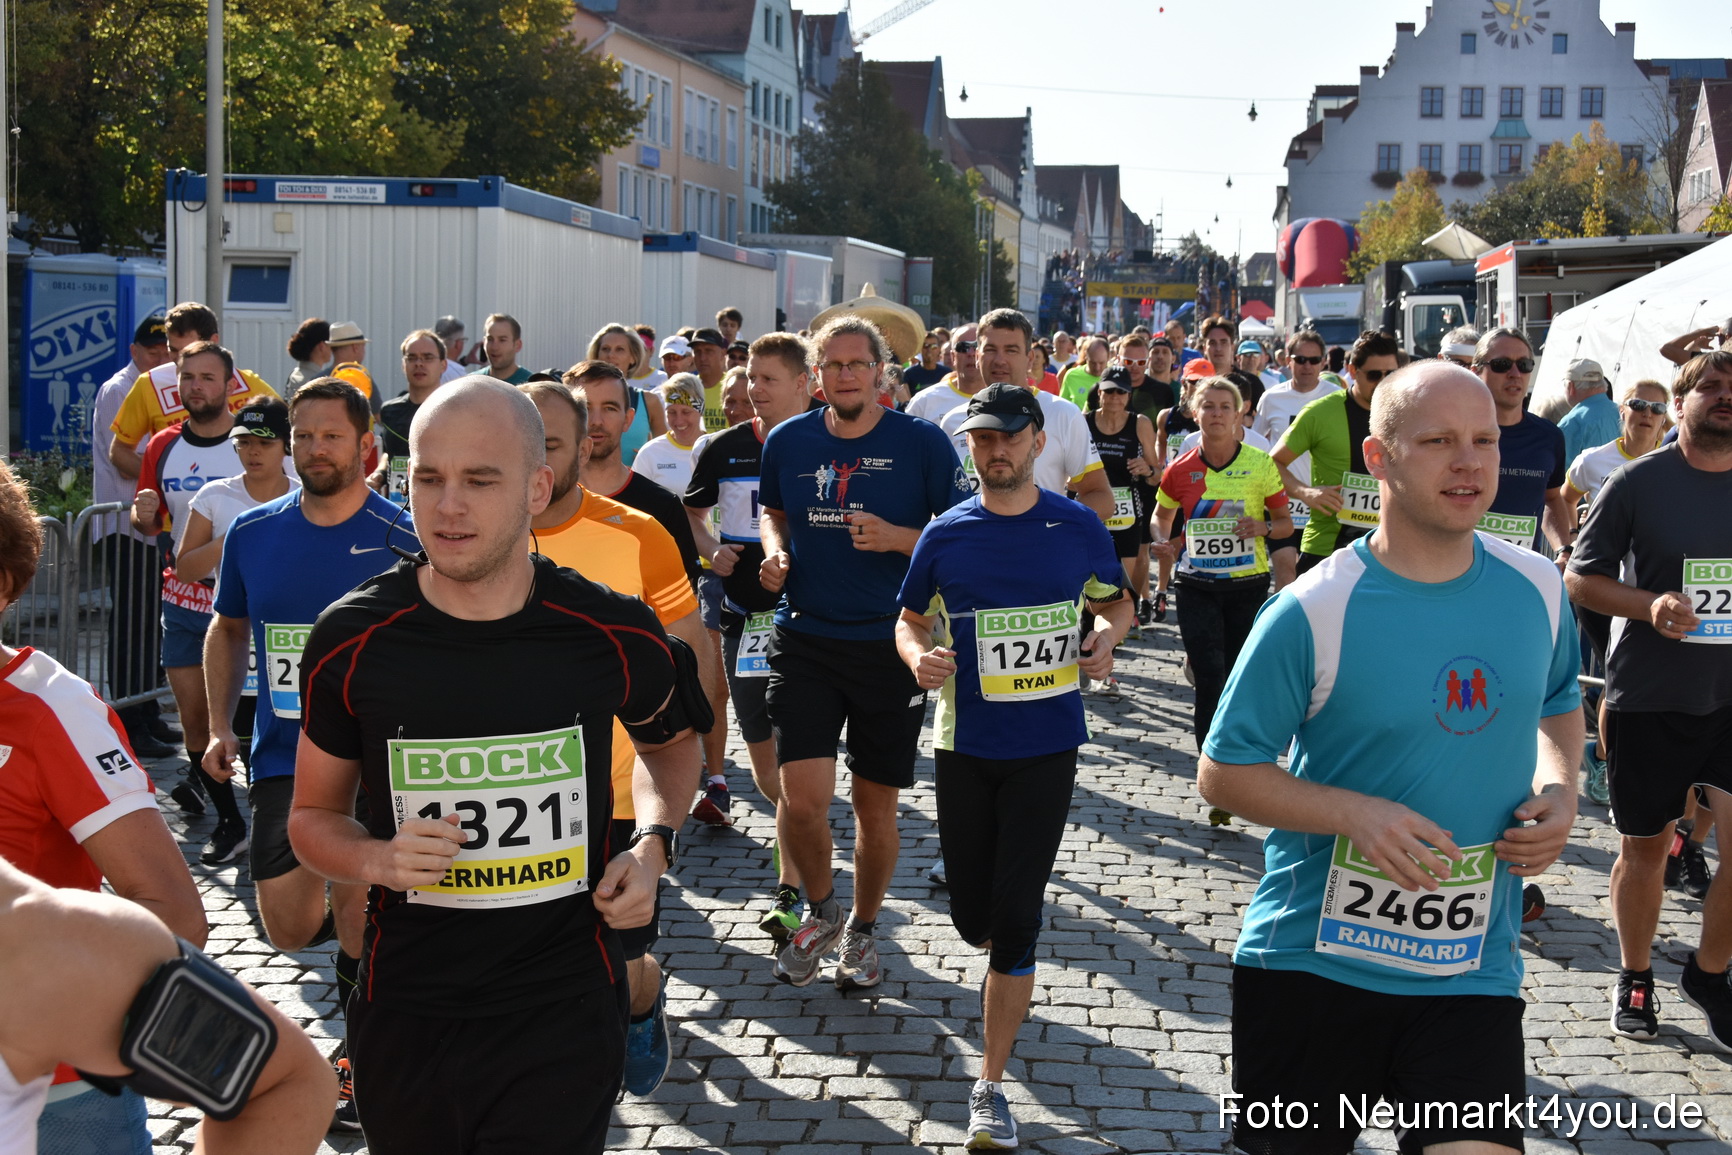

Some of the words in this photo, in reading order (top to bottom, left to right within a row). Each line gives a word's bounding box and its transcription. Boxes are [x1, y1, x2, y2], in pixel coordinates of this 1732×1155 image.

[52, 281, 76, 290] 08141
[82, 283, 97, 291] 536
[98, 283, 109, 292] 80
[1121, 286, 1160, 295] START
[1098, 449, 1123, 457] gensburg
[1508, 468, 1546, 478] METRAWATT
[1195, 538, 1246, 555] 2691
[1695, 589, 1732, 614] 22
[984, 606, 1070, 634] BOCK
[992, 634, 1069, 669] 1247
[1014, 674, 1055, 690] RYAN
[403, 737, 571, 784] BOCK
[432, 857, 571, 888] ERNHARD
[1343, 880, 1476, 931] 2466
[1338, 926, 1467, 960] RAINHARD
